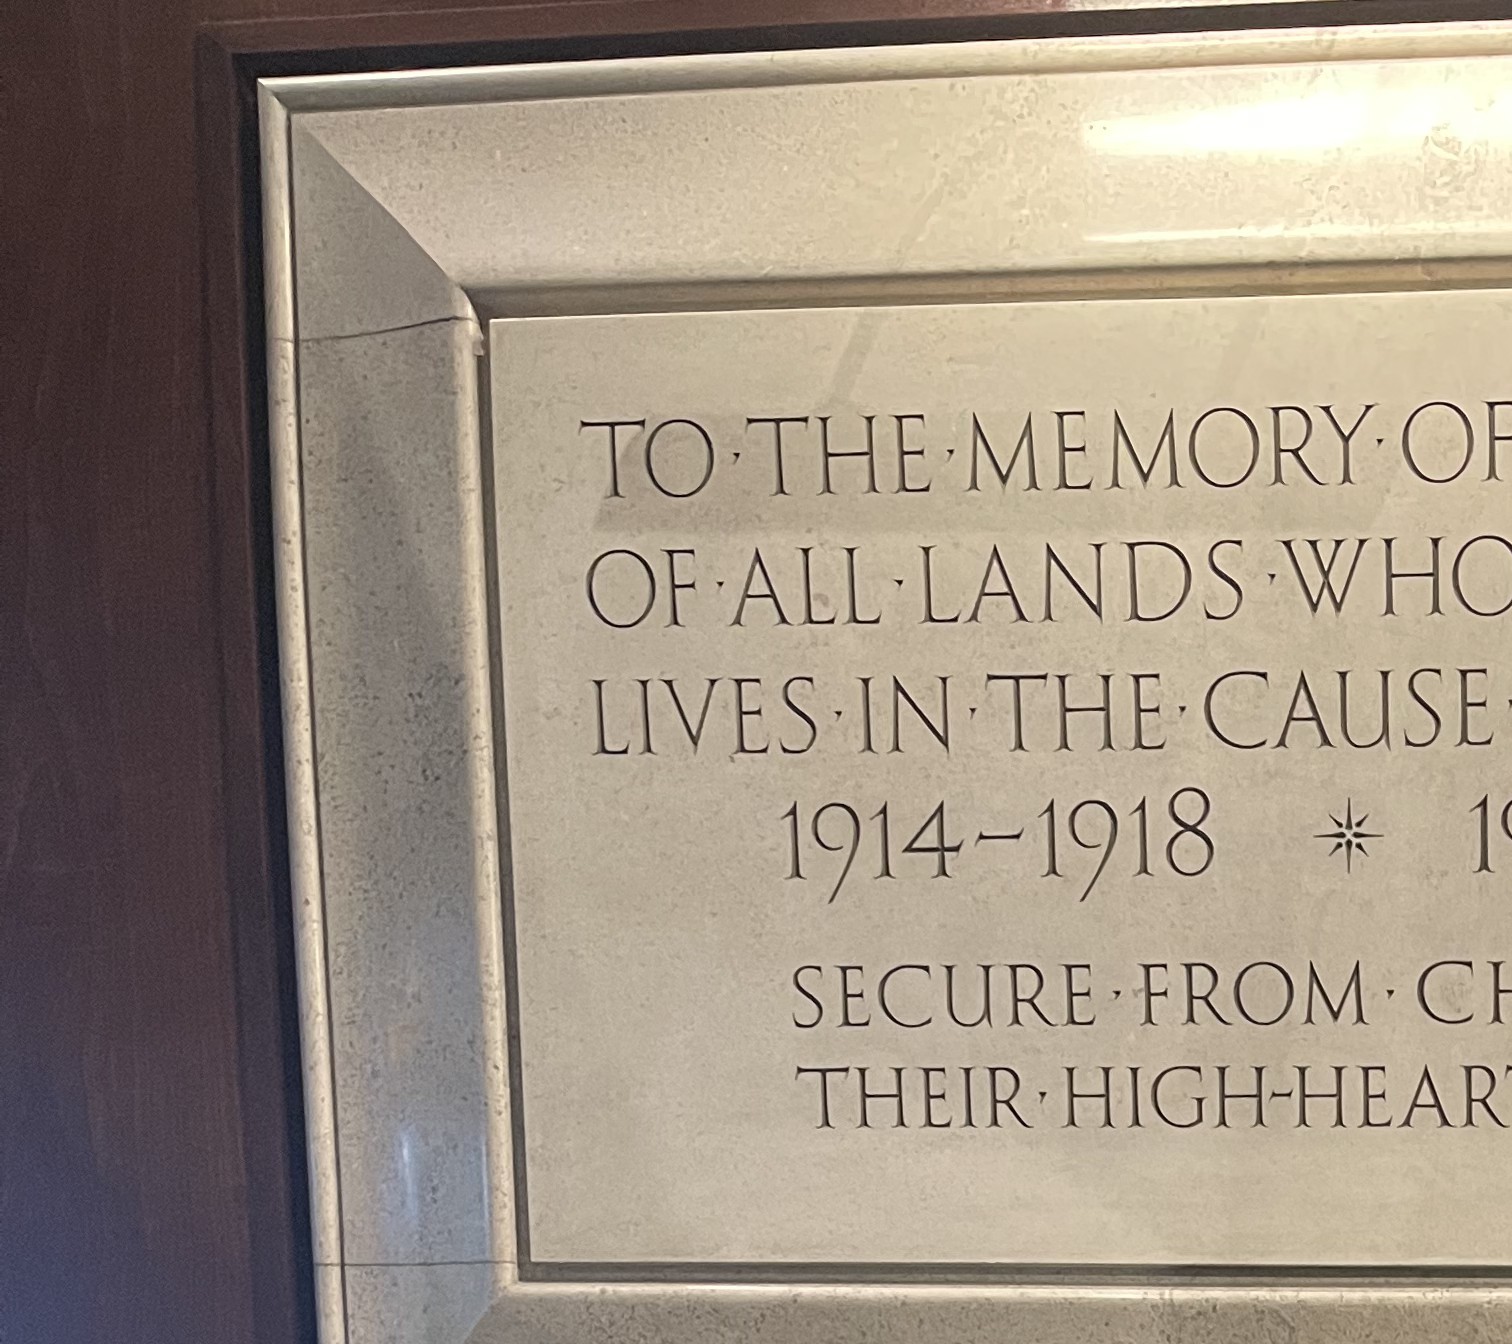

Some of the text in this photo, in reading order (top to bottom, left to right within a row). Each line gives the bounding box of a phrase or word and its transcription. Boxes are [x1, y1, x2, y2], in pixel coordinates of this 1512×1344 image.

[581, 418, 714, 498] TO
[746, 413, 932, 497] THE
[966, 402, 1379, 493] MEMORY
[585, 548, 697, 629] OF
[728, 545, 882, 626] ALL
[918, 538, 1245, 626] LANDS
[591, 675, 818, 757] LIVES
[857, 674, 951, 757] IN
[986, 671, 1168, 754] THE
[1203, 667, 1494, 753] CAUSE
[791, 963, 1097, 1029] SECURE
[1138, 958, 1370, 1027] FROM
[794, 1065, 1034, 1130] THEIR
